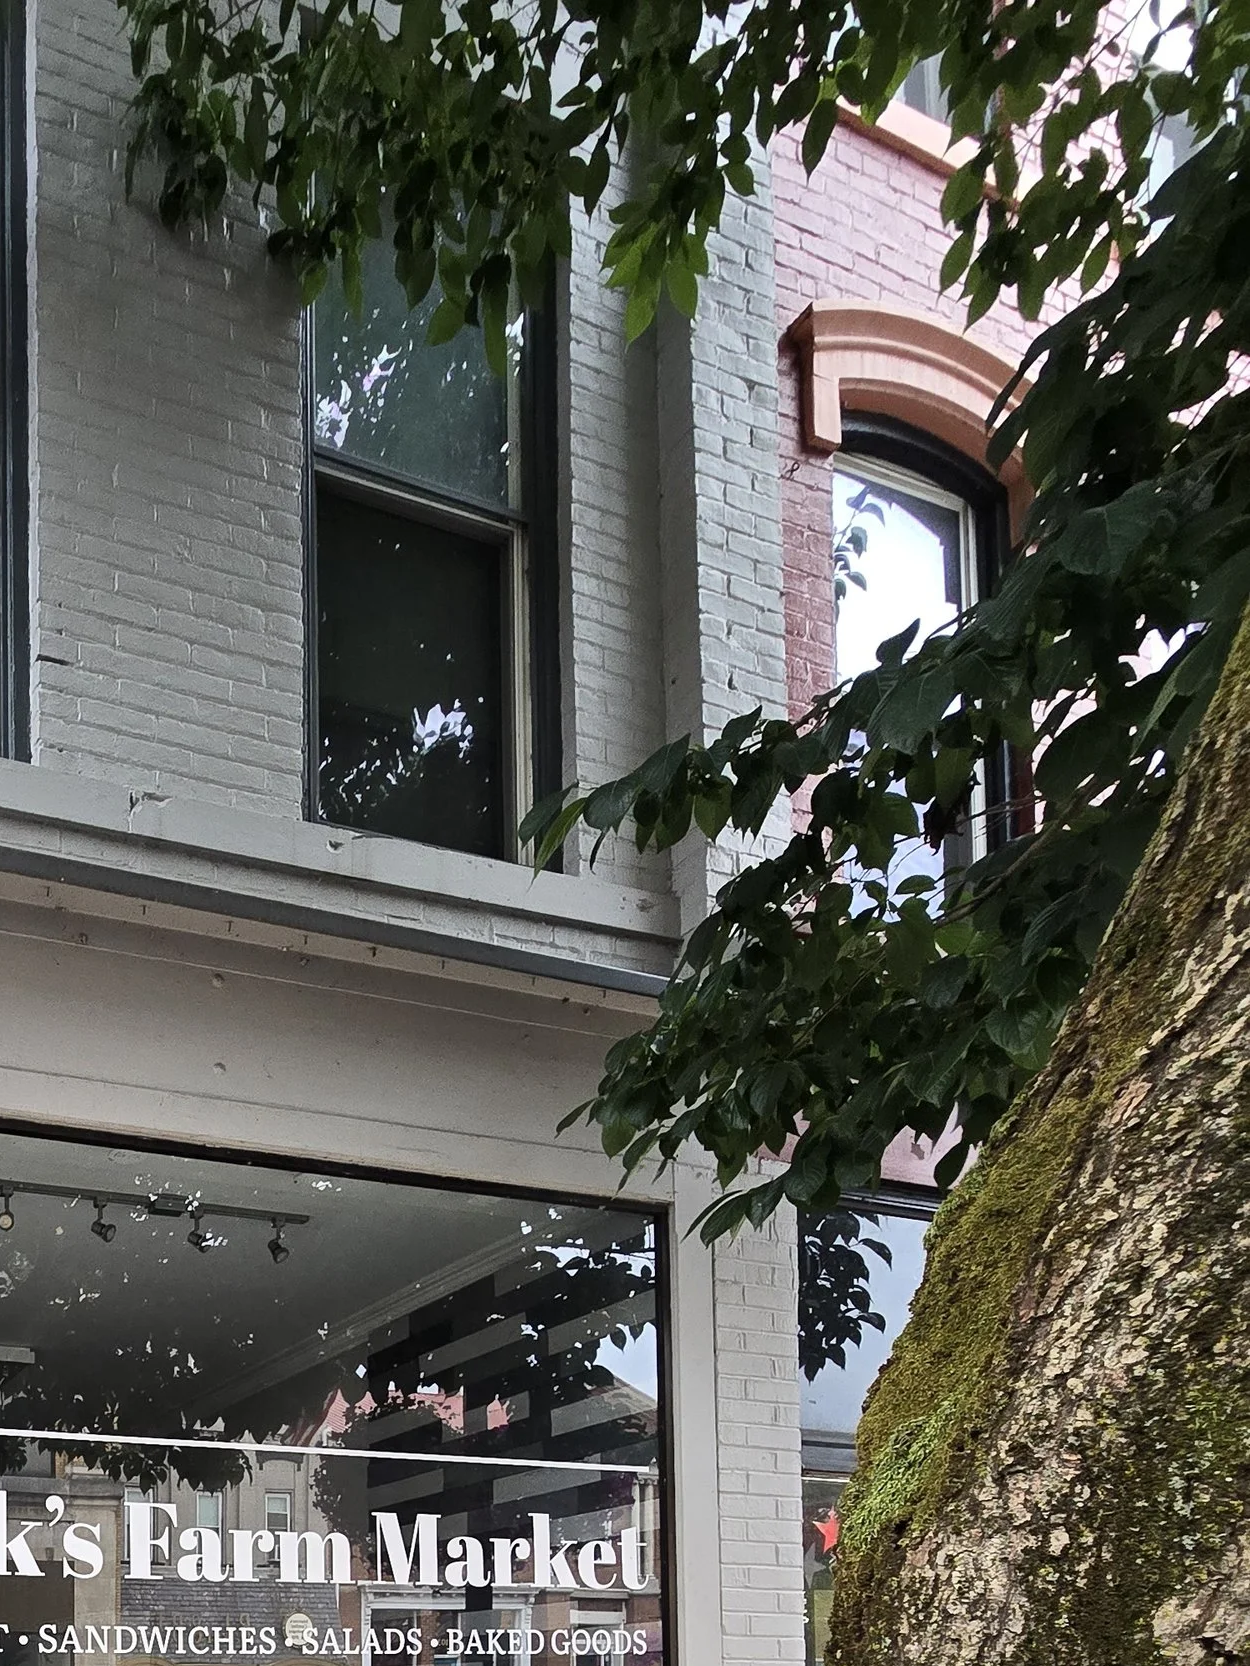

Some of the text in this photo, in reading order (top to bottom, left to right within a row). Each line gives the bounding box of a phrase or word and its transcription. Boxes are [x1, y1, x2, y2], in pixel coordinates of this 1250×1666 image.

[123, 1501, 356, 1584] Farm
[371, 1512, 649, 1590] Market
[38, 1624, 276, 1655] SANDWICHES
[302, 1627, 422, 1655] SALADS
[446, 1629, 545, 1655] BAKED
[551, 1629, 647, 1655] GOODS
